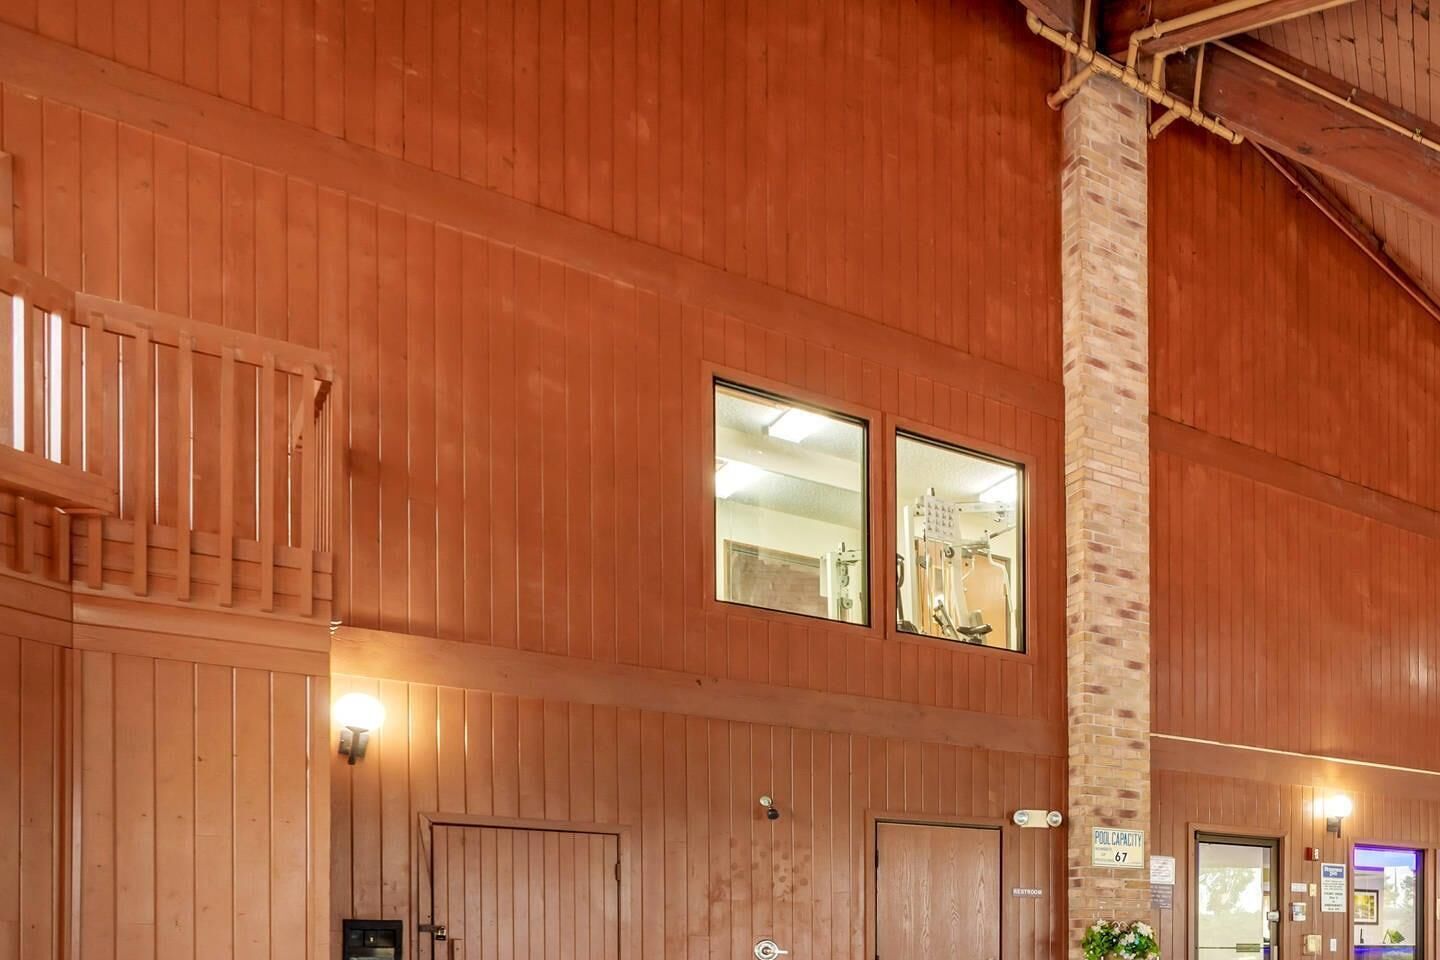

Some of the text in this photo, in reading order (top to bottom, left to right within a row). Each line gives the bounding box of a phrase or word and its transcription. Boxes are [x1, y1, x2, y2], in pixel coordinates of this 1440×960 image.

[1095, 830, 1142, 848] POOL CAPACITY
[1115, 852, 1127, 863] 67
